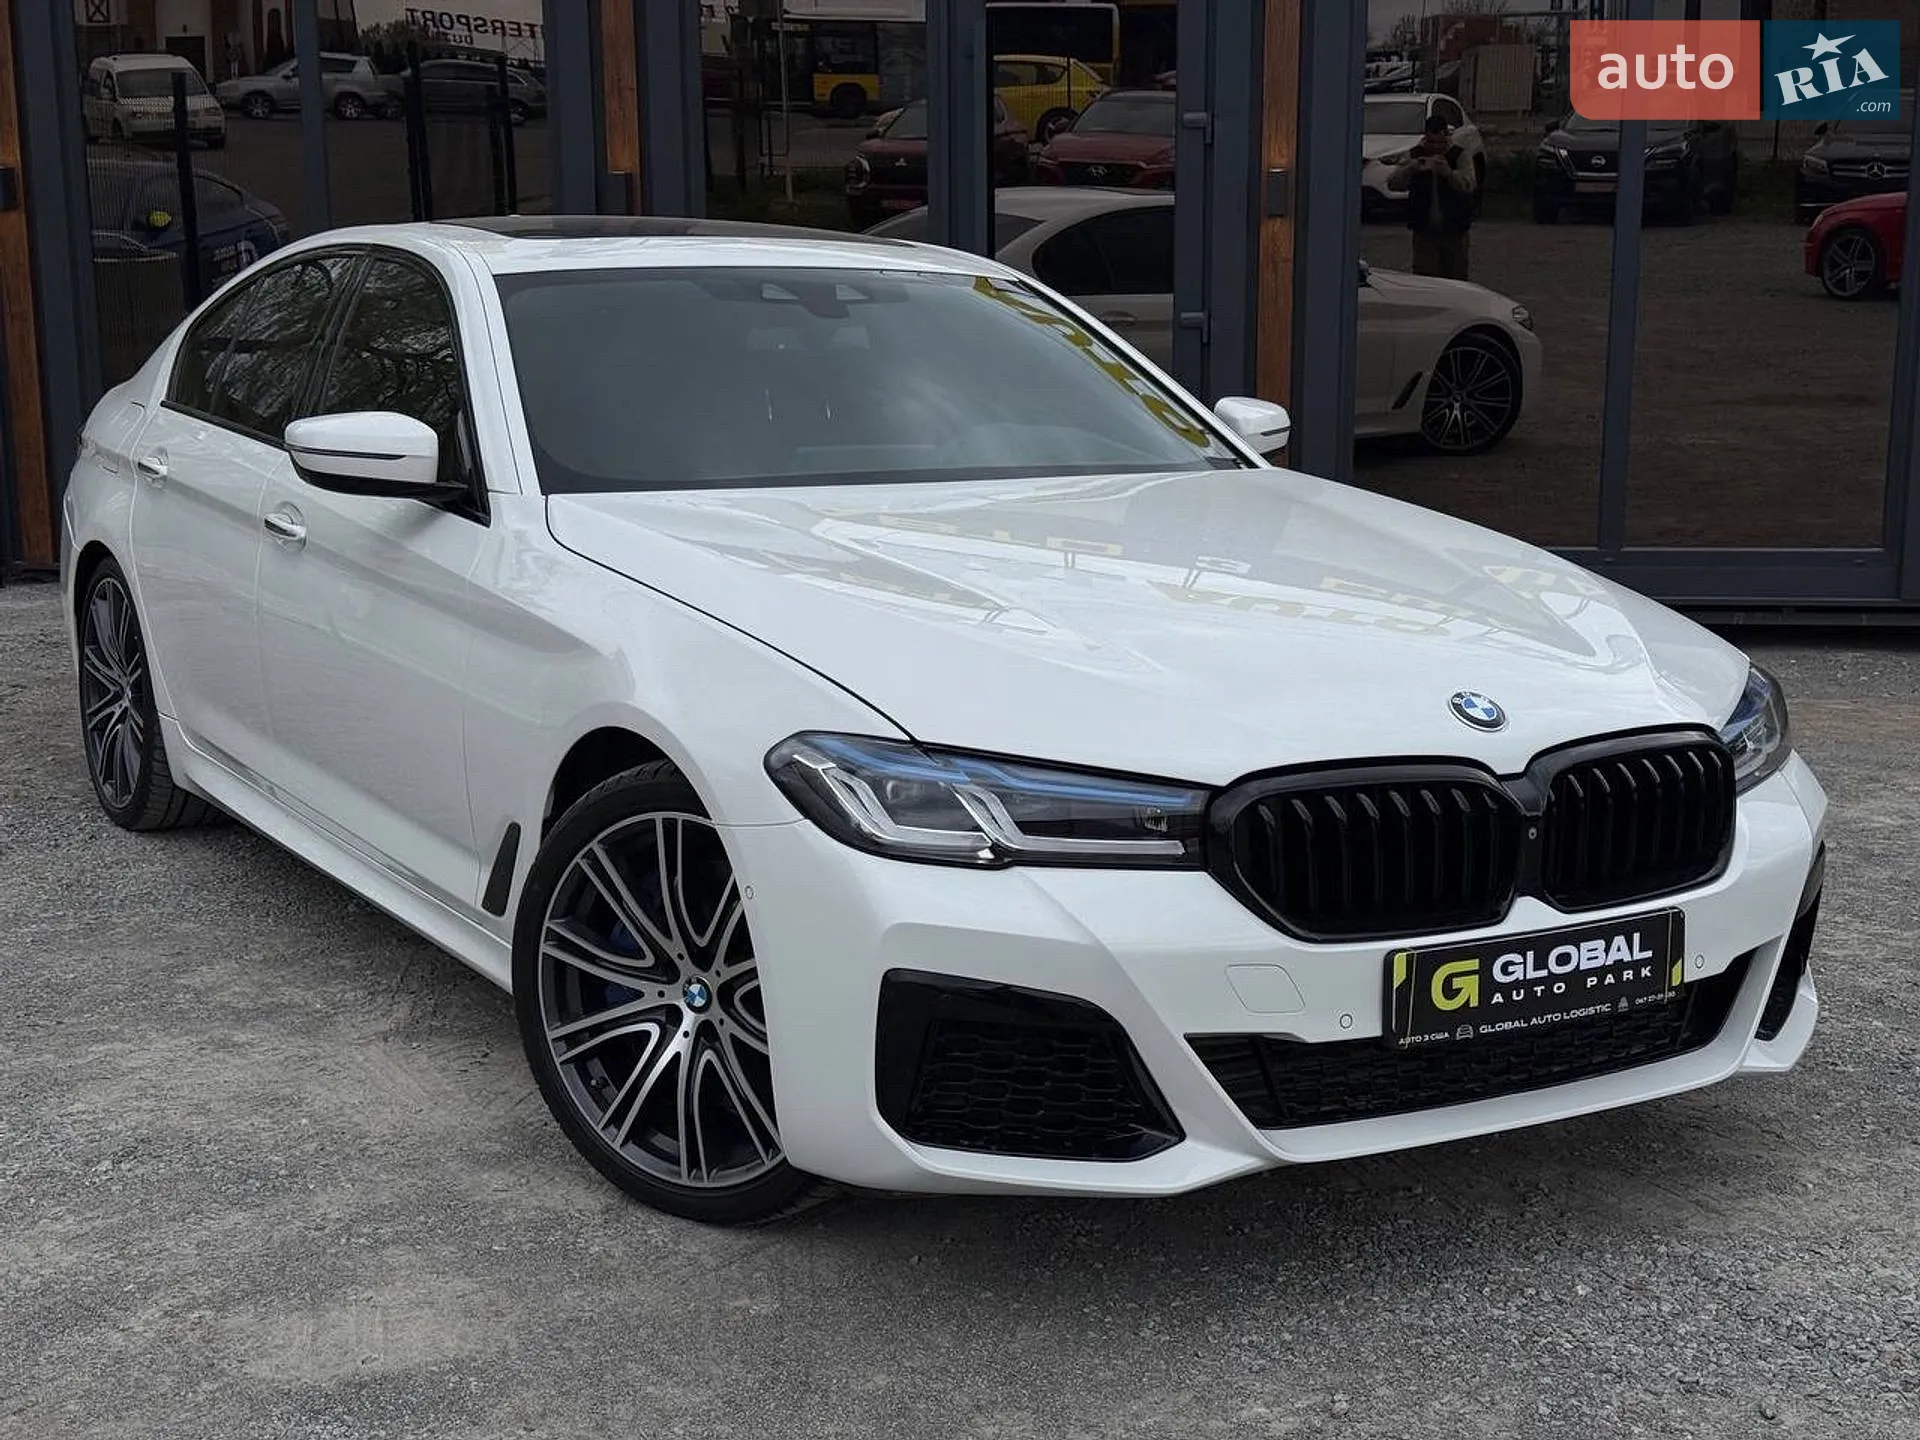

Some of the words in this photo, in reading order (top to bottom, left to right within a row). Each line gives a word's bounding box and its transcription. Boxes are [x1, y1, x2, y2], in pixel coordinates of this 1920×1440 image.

[1491, 932, 1653, 983] GLOBAL
[1491, 983, 1567, 1004] AUTO
[1587, 966, 1654, 989] PARK
[1479, 1020, 1528, 1033] GLOBAL
[1530, 1013, 1561, 1026] AUTO
[1563, 1003, 1612, 1019] LOGISTIC
